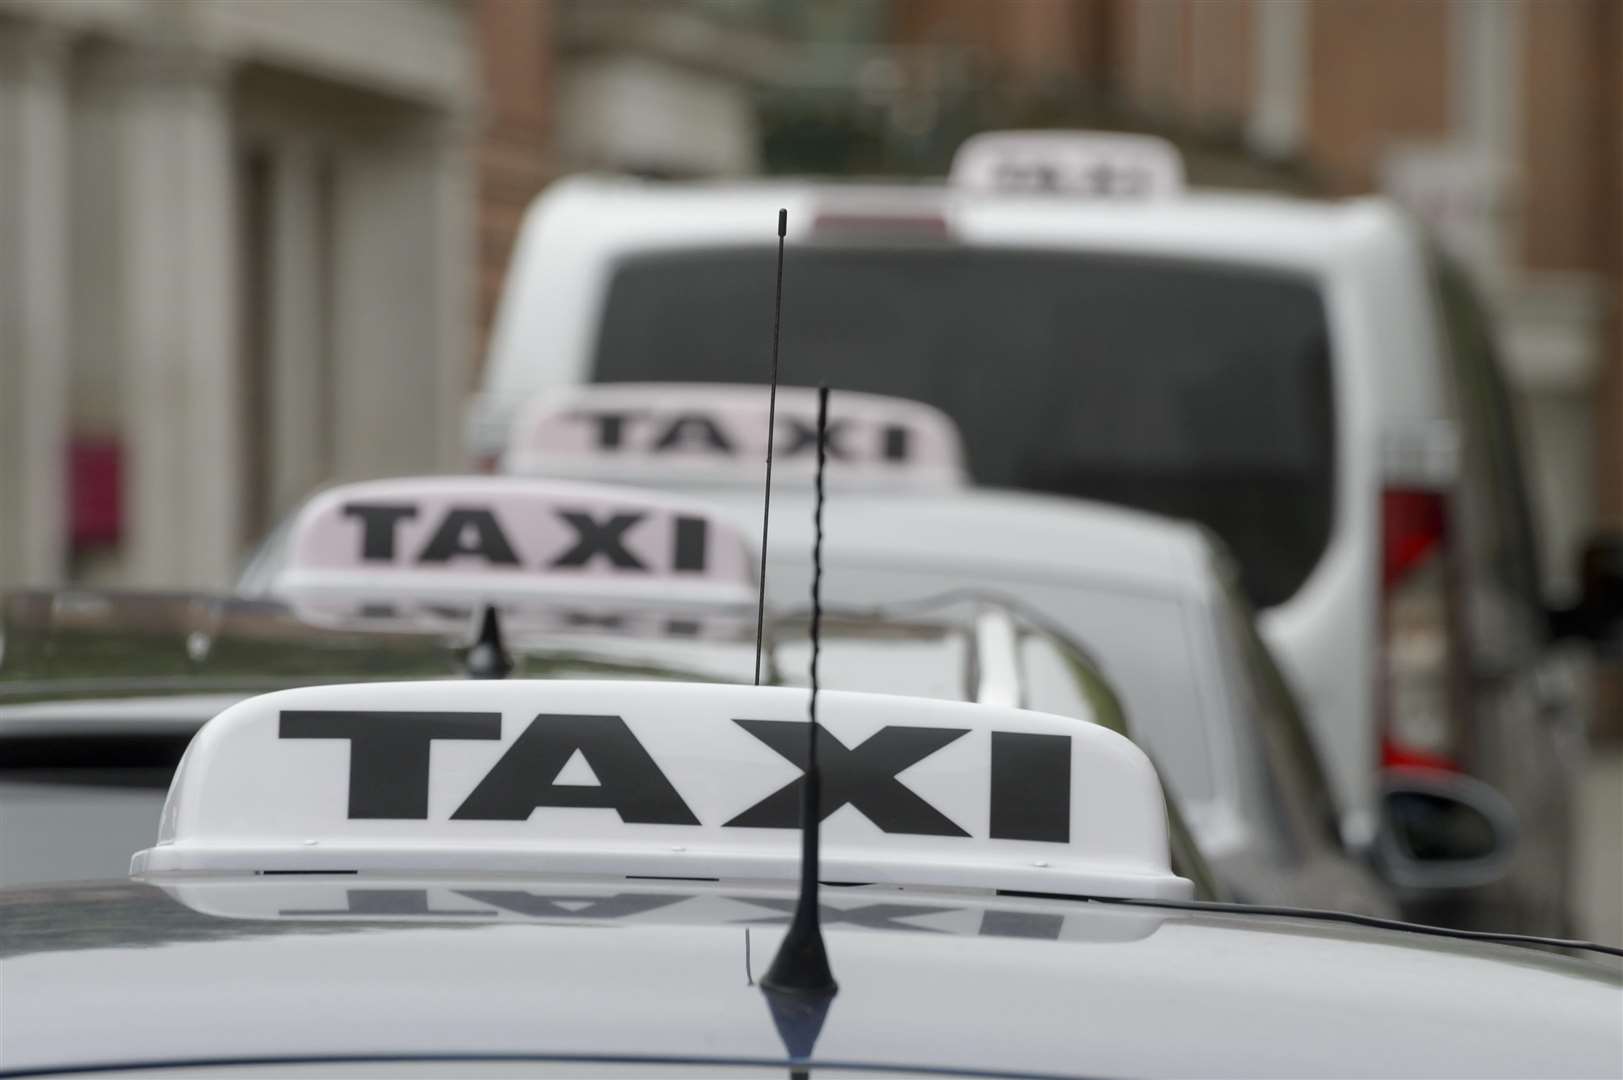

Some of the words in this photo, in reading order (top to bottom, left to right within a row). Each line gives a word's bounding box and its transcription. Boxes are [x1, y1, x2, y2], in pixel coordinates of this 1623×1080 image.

[566, 408, 914, 464] TAXI
[342, 503, 710, 575] TAXI
[279, 710, 1072, 844] TAXI
